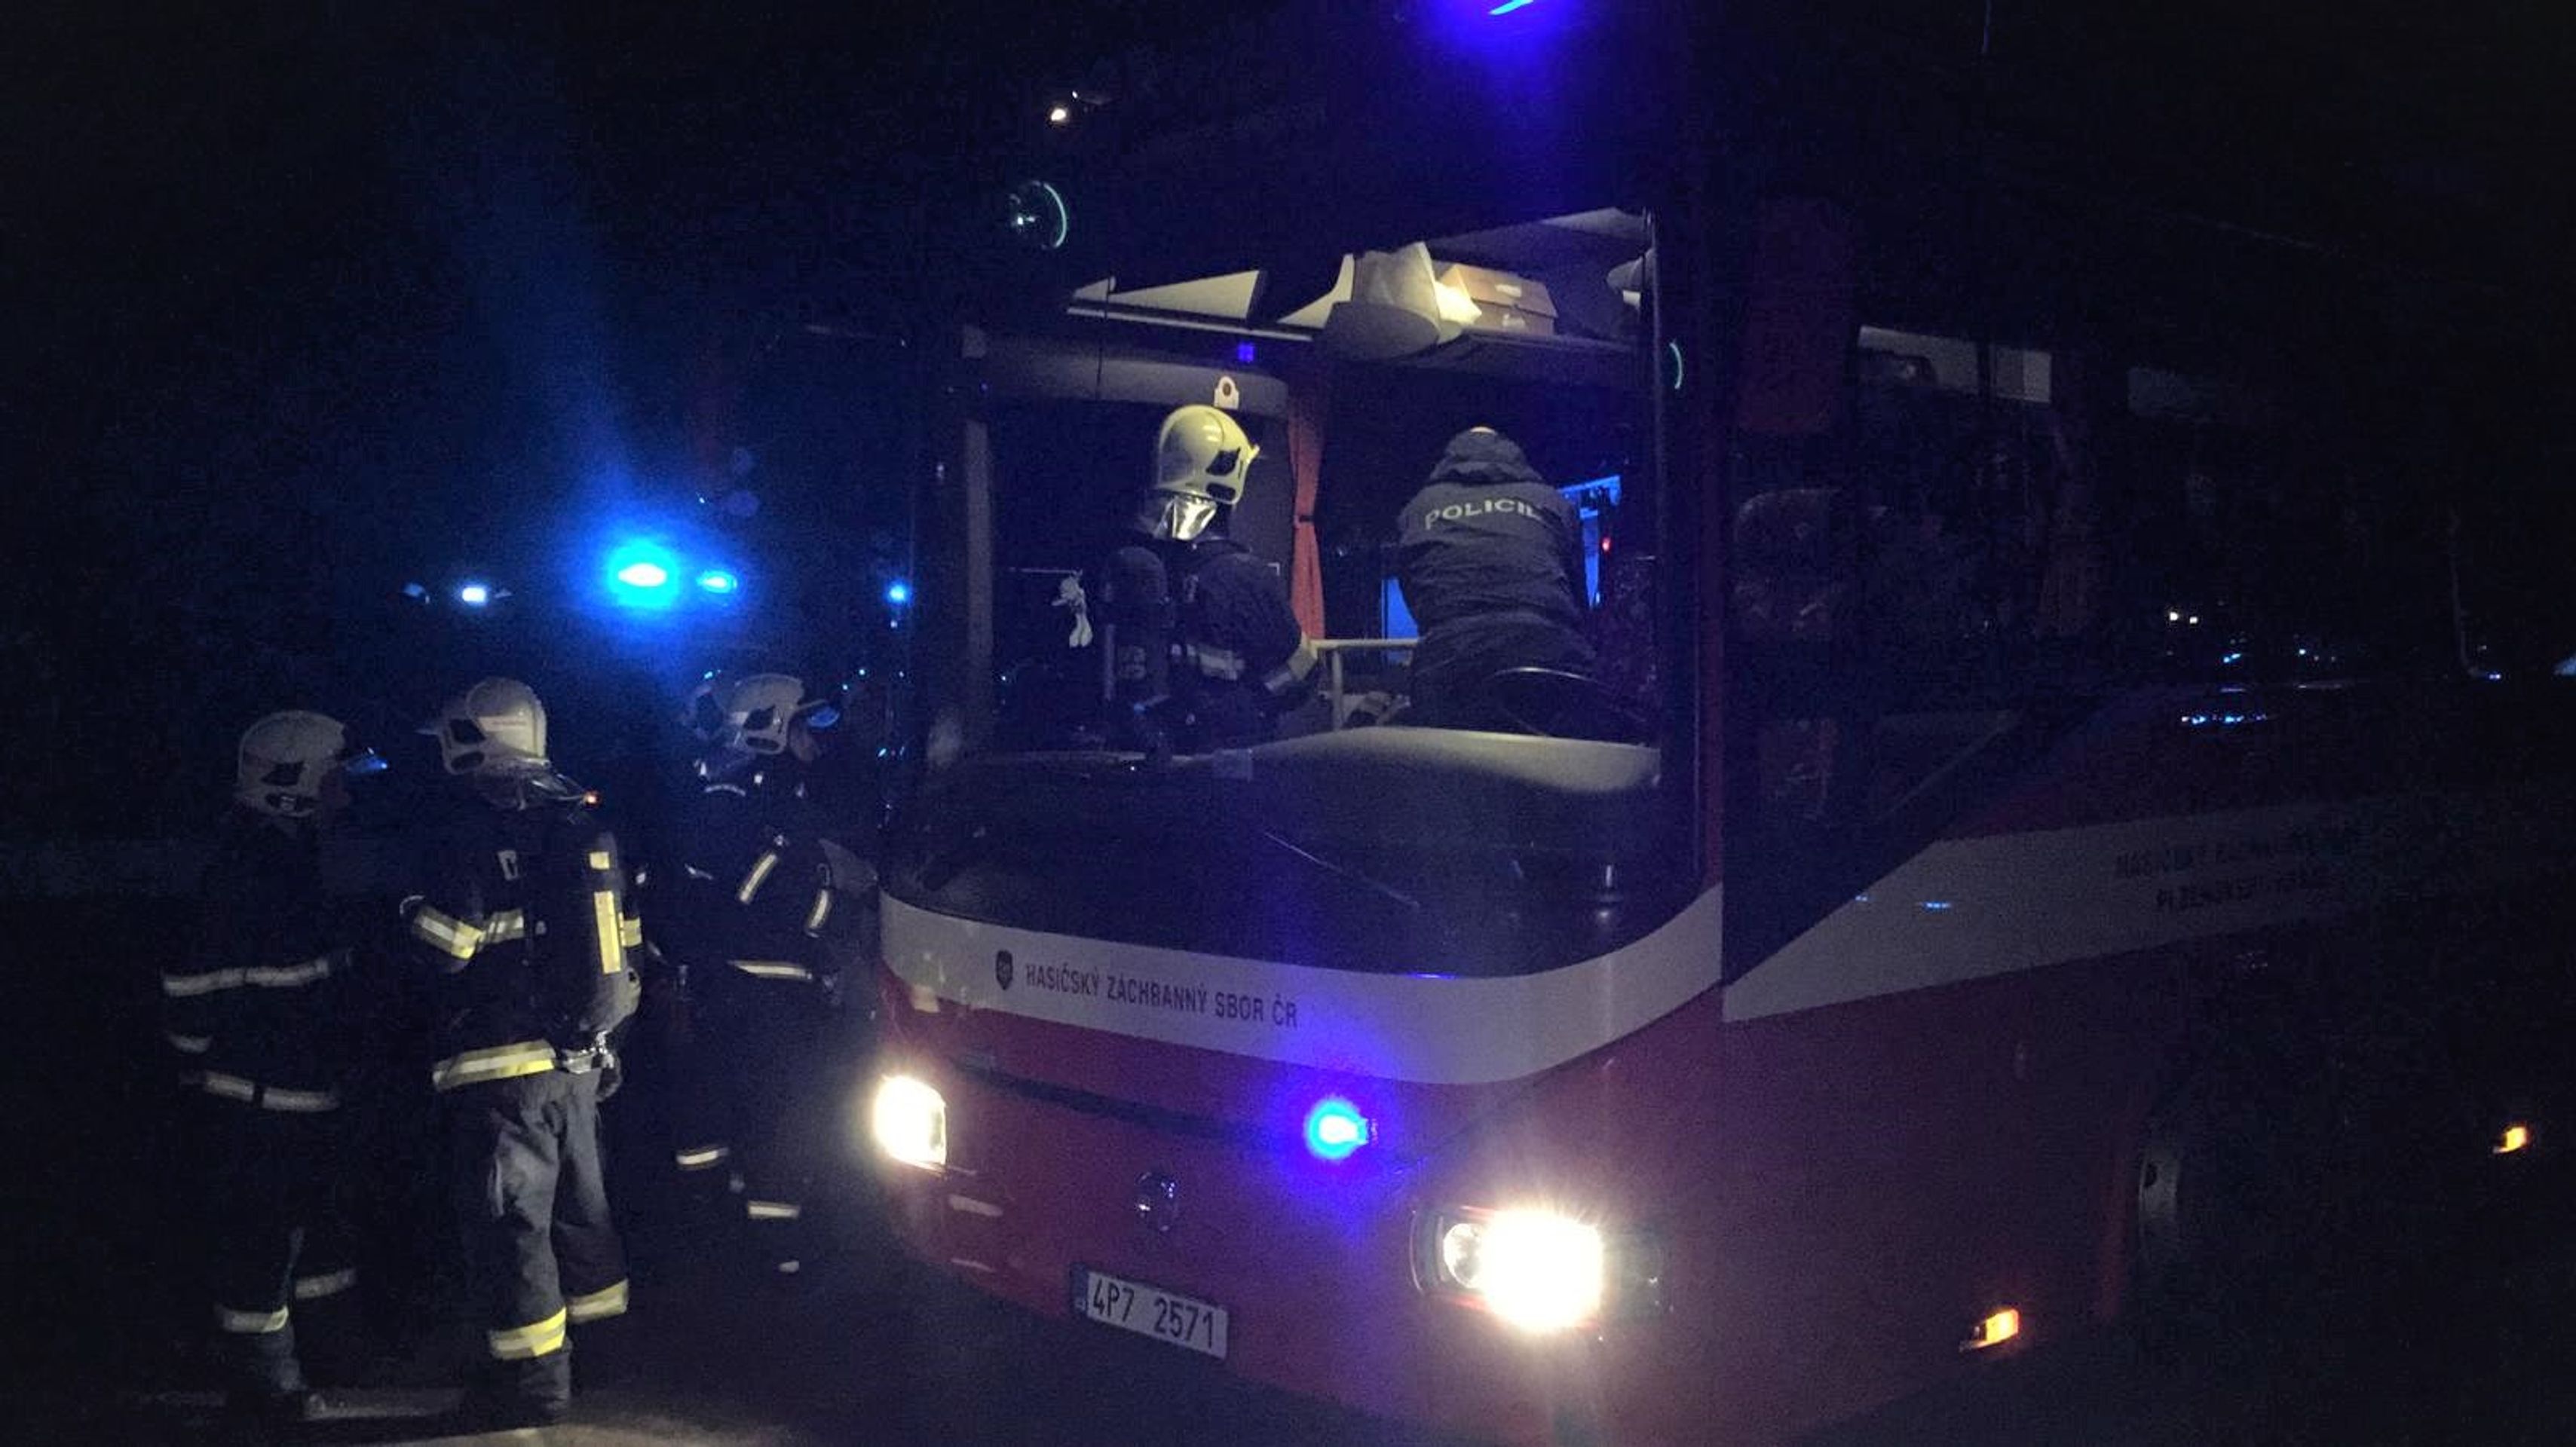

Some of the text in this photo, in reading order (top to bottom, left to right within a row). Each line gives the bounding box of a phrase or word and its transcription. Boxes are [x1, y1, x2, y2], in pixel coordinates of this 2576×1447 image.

[1025, 962, 1297, 1029] HASIČSKÝ ZÁCHRANNÝ SBOR ČR
[1092, 1278, 1213, 1349] 4P7 2571
